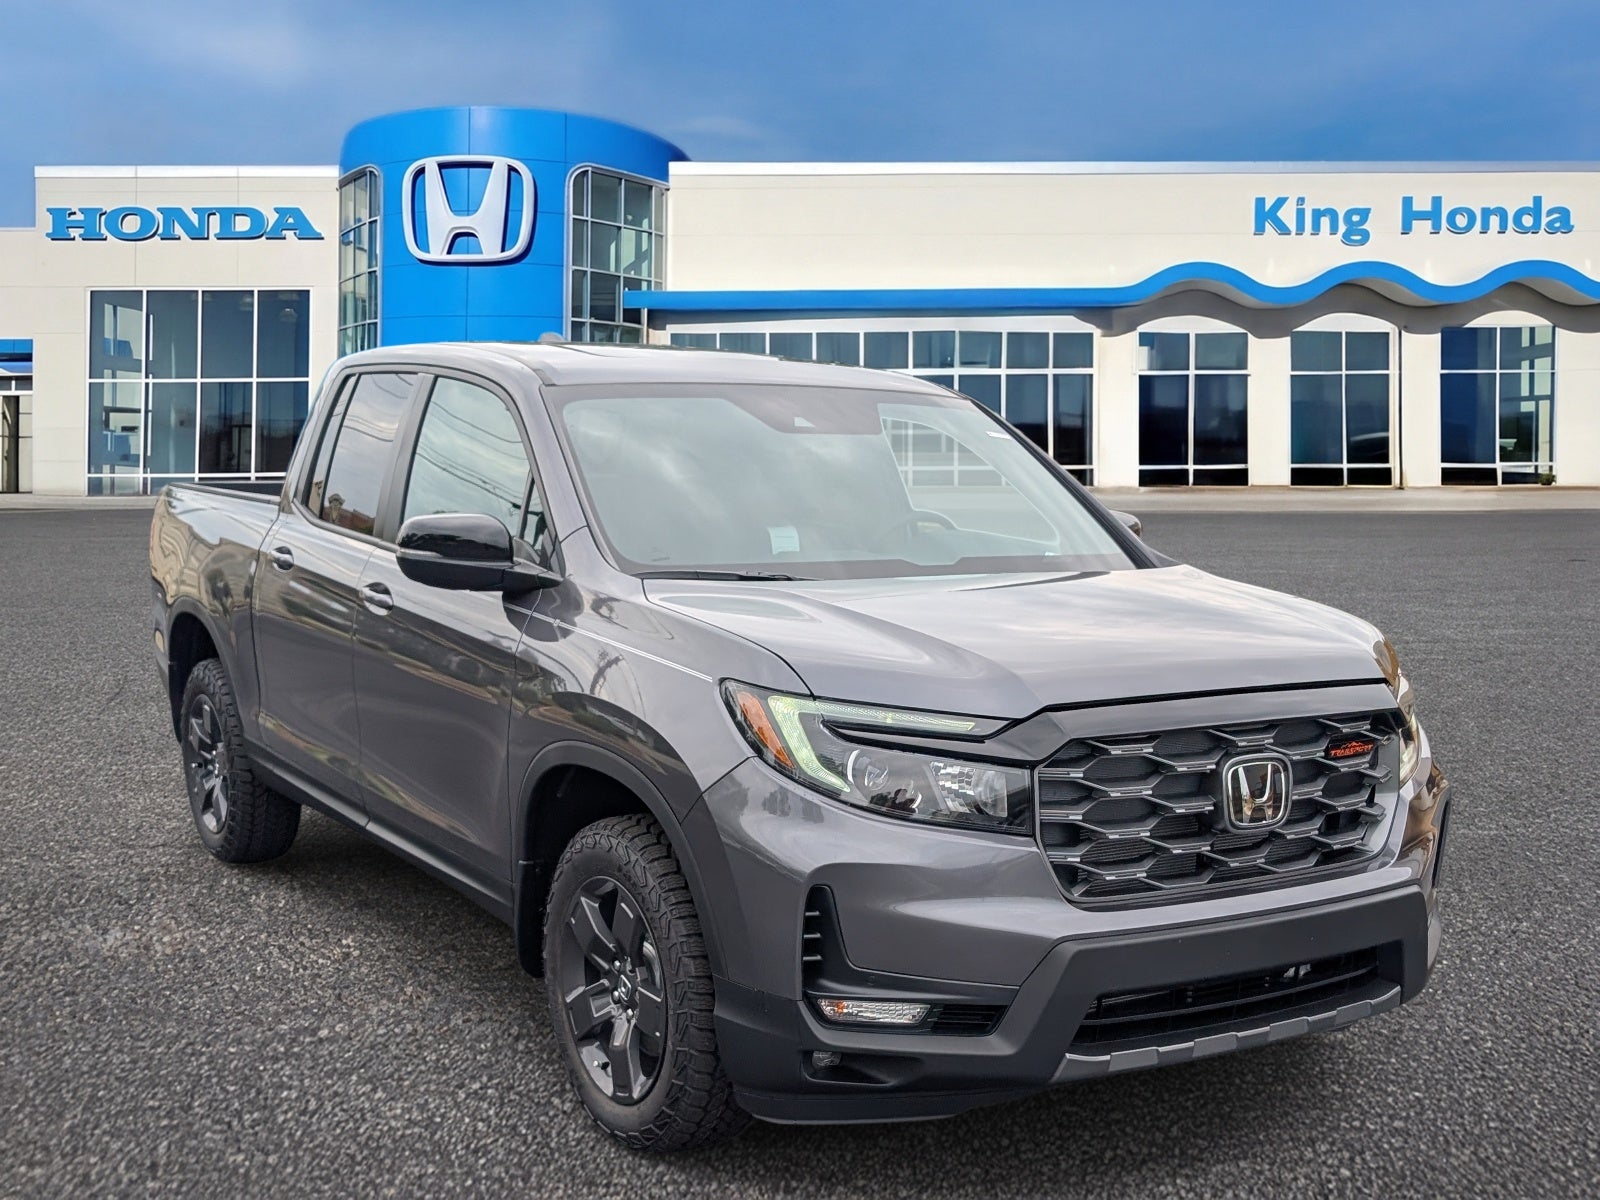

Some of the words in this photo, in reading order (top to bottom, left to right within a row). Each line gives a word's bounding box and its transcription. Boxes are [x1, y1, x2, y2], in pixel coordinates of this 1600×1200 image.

[46, 206, 324, 241] HONDA
[1253, 196, 1372, 246] King
[1401, 195, 1575, 234] Honda
